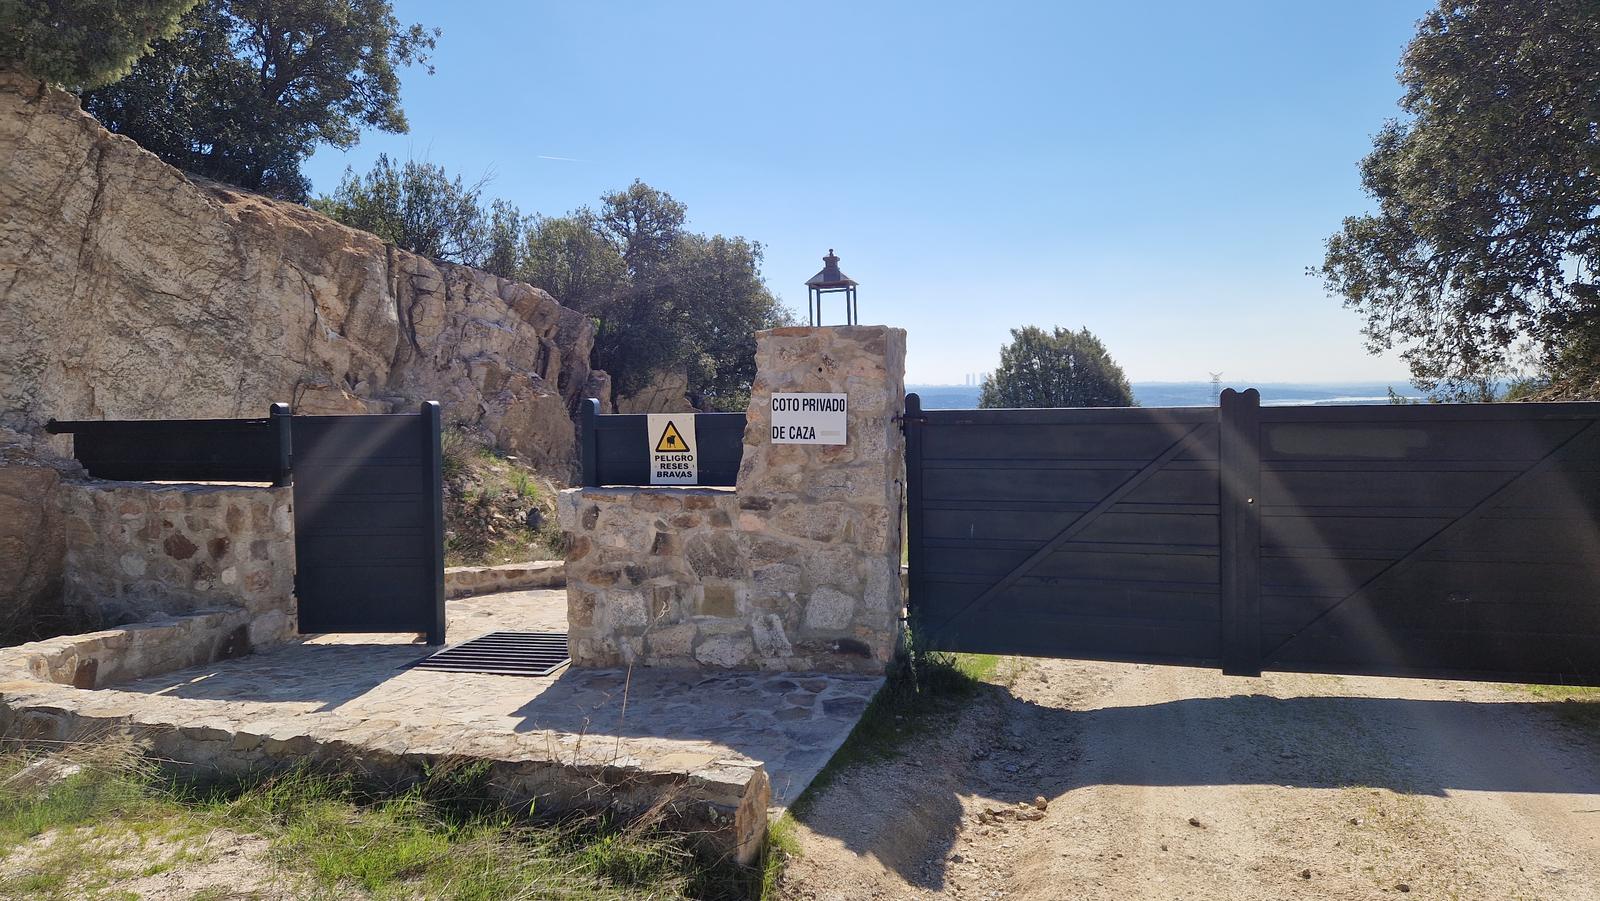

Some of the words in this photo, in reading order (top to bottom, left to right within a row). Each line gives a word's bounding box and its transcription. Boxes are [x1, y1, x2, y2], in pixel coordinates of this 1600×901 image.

[772, 398, 799, 411] COTO
[802, 398, 845, 412] PRIVADO
[772, 426, 786, 439] DE
[789, 426, 816, 440] CAZA
